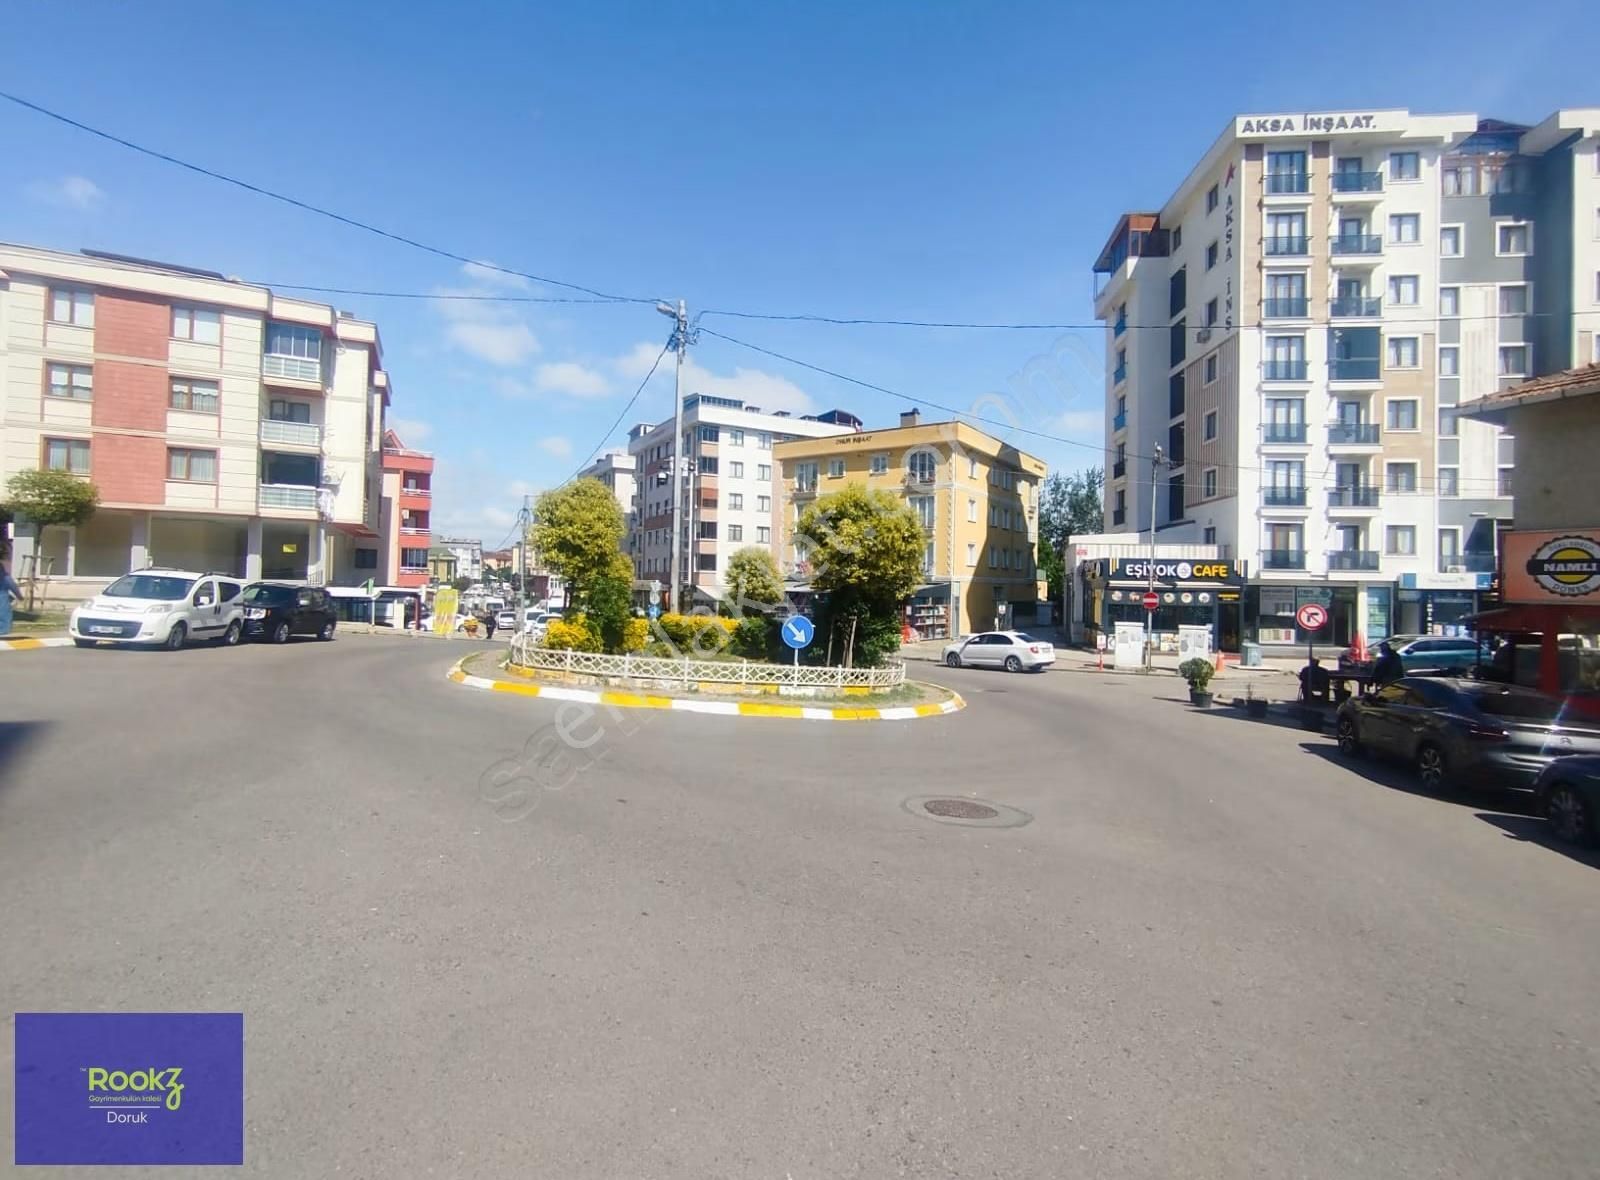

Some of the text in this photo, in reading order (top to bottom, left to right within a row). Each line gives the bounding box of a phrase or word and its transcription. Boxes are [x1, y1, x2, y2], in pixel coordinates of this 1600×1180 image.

[1242, 119, 1295, 133] AKSA
[1225, 195, 1233, 262] AKSA
[1193, 565, 1228, 577] CAFE
